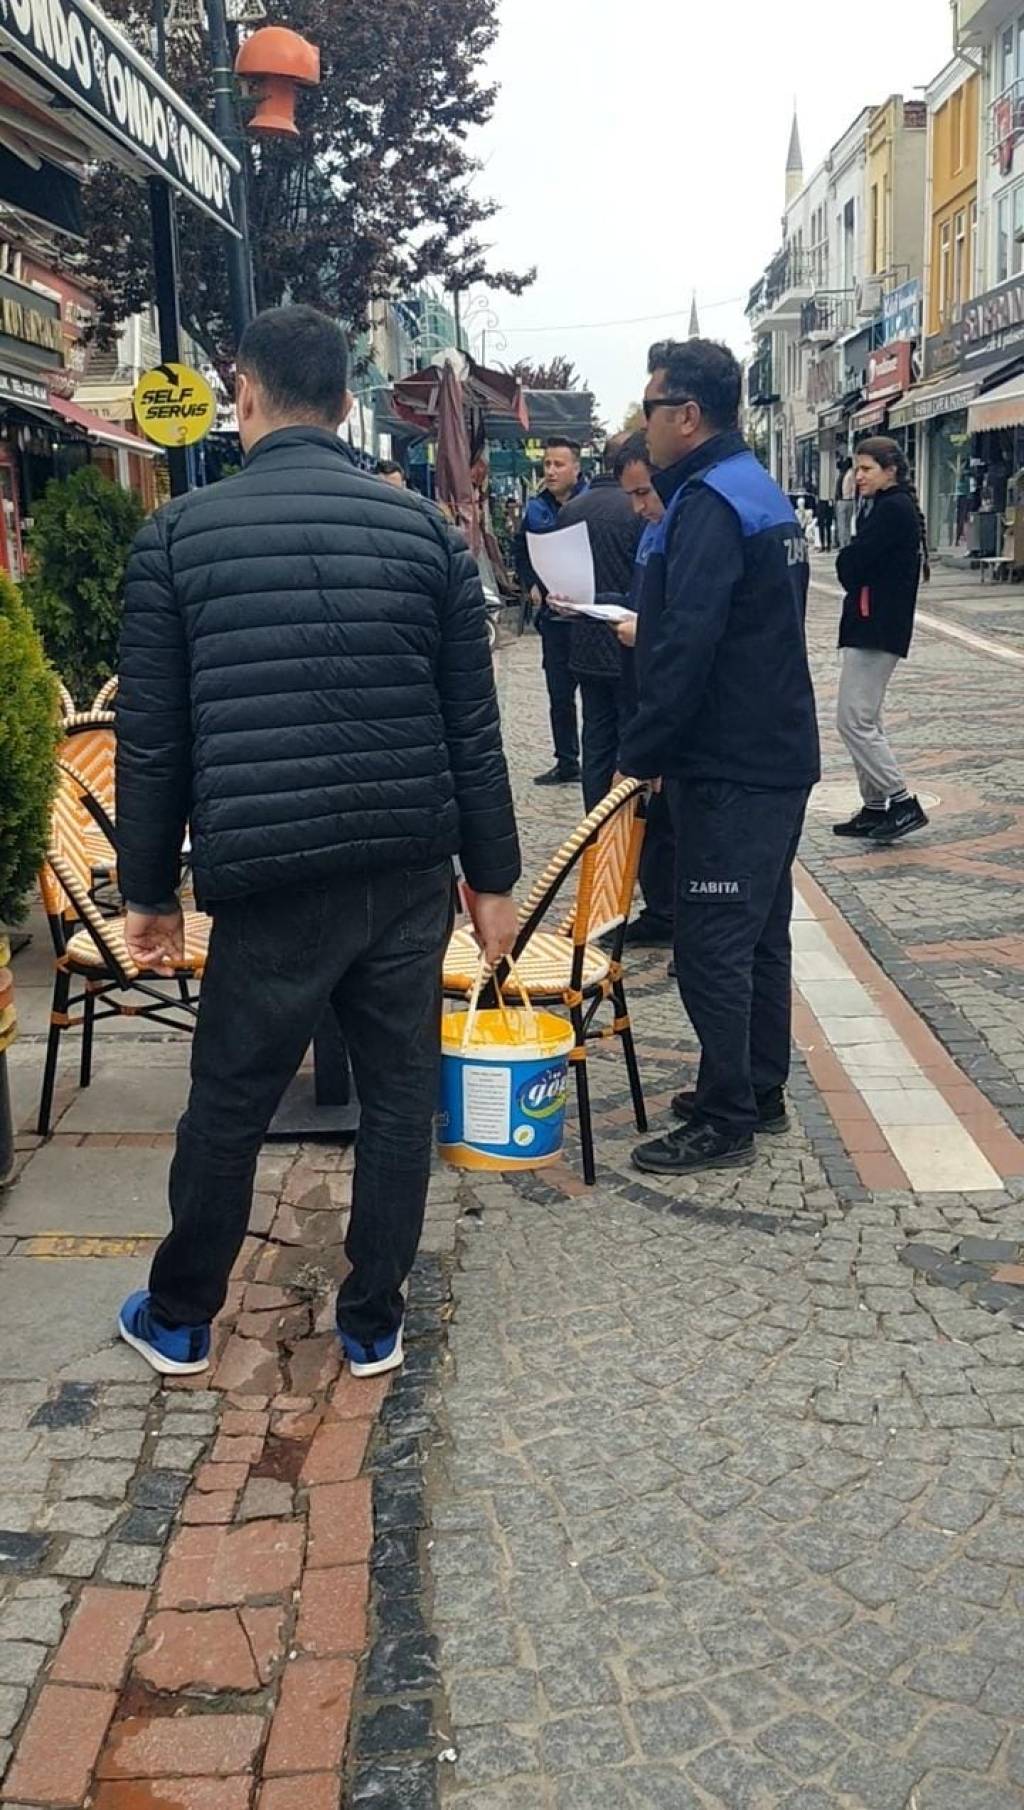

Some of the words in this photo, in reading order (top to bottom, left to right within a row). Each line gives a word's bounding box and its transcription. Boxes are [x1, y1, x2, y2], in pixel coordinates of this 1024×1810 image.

[107, 53, 169, 160] ONDO
[180, 124, 223, 209] ONDO
[141, 387, 194, 405] SELF
[689, 881, 739, 894] ZABITA
